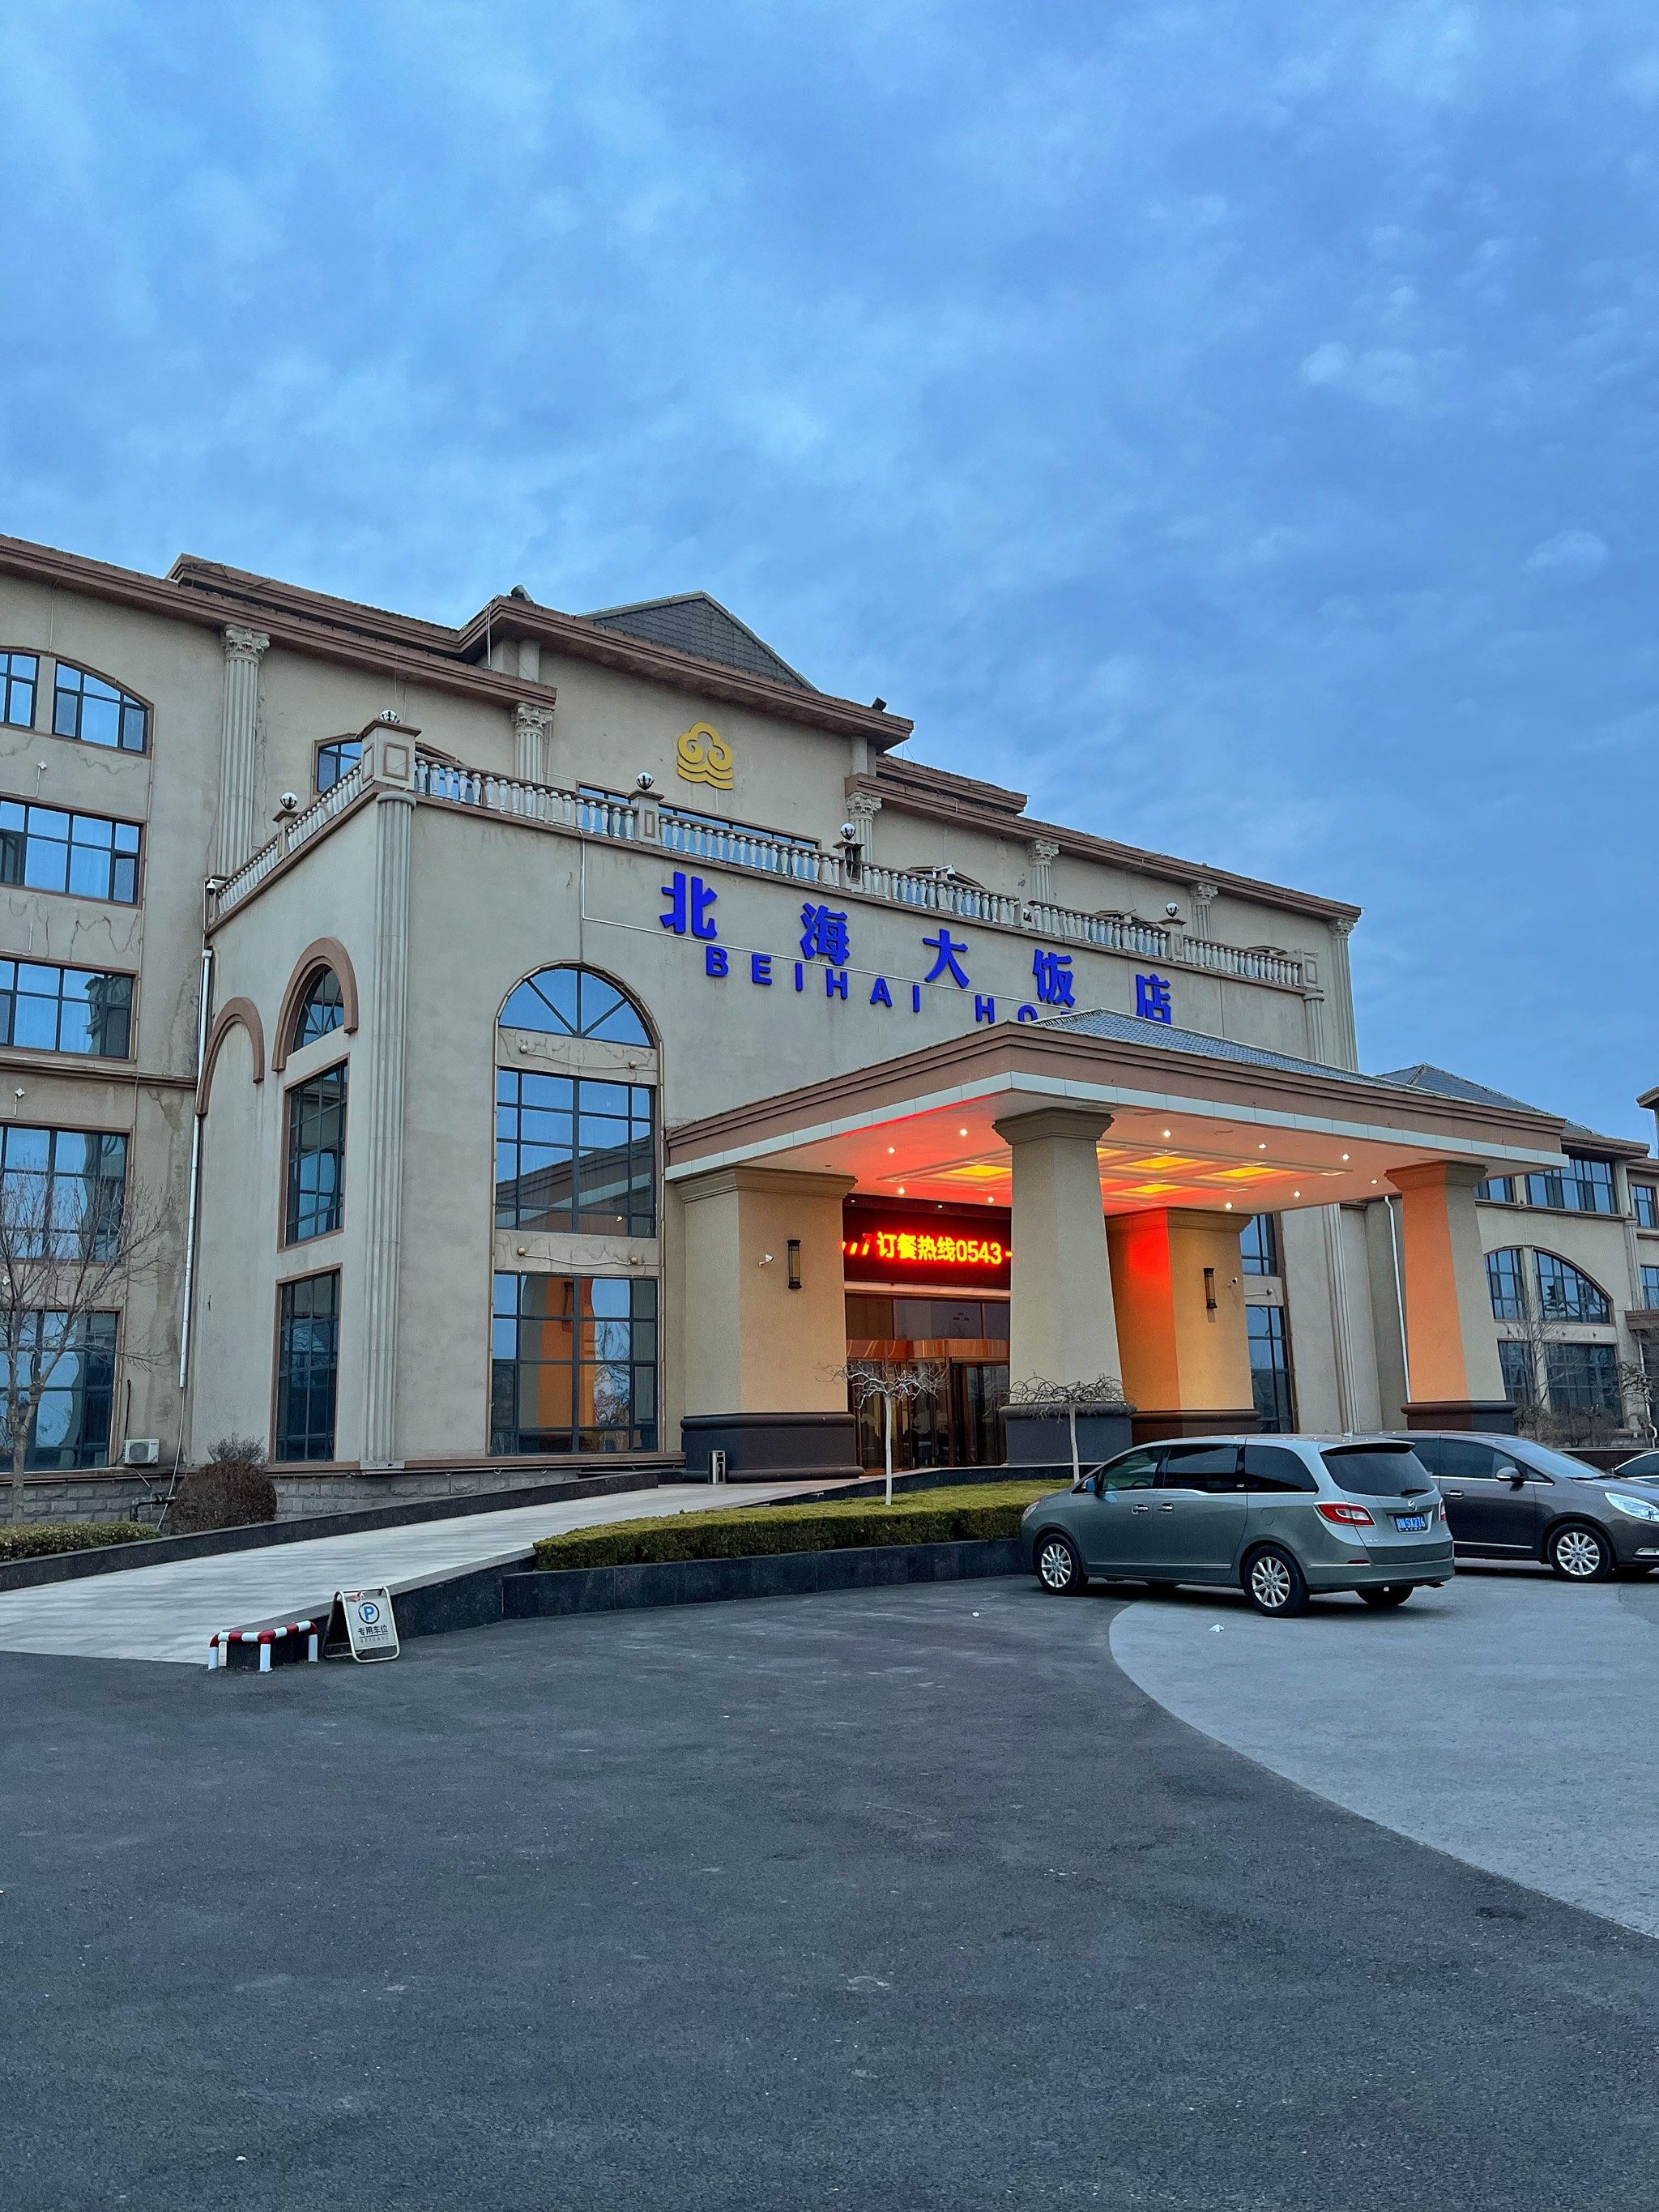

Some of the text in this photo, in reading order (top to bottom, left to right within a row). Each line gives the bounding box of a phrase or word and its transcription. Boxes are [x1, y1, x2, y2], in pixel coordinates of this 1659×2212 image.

[659, 870, 1172, 1025] 北海大饭店
[706, 945, 921, 1013] BEIHAI
[358, 1625, 388, 1635] 专用车位
[364, 1606, 374, 1621] P
